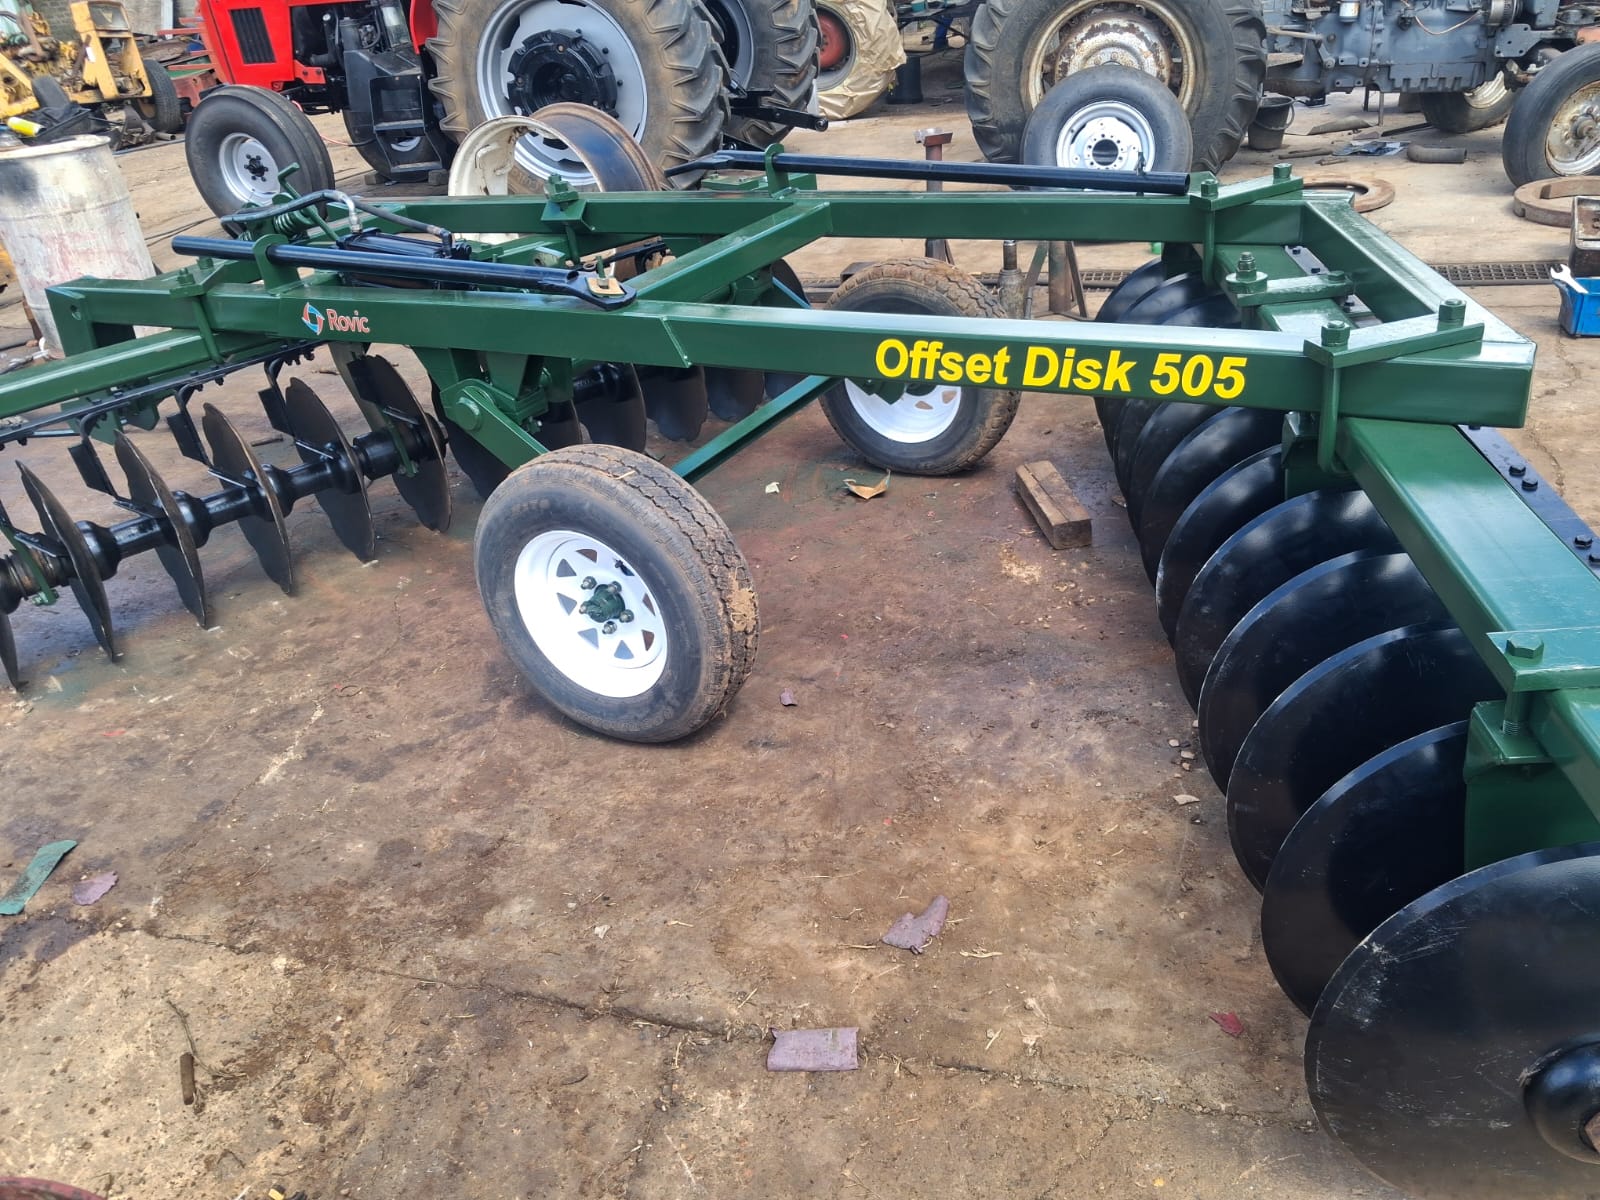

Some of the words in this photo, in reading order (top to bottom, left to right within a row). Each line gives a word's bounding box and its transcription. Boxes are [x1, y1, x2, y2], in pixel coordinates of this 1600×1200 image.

[326, 308, 370, 333] Rovic
[875, 338, 1011, 385] Offset
[1022, 345, 1137, 393] Disk
[1150, 352, 1248, 400] 505
